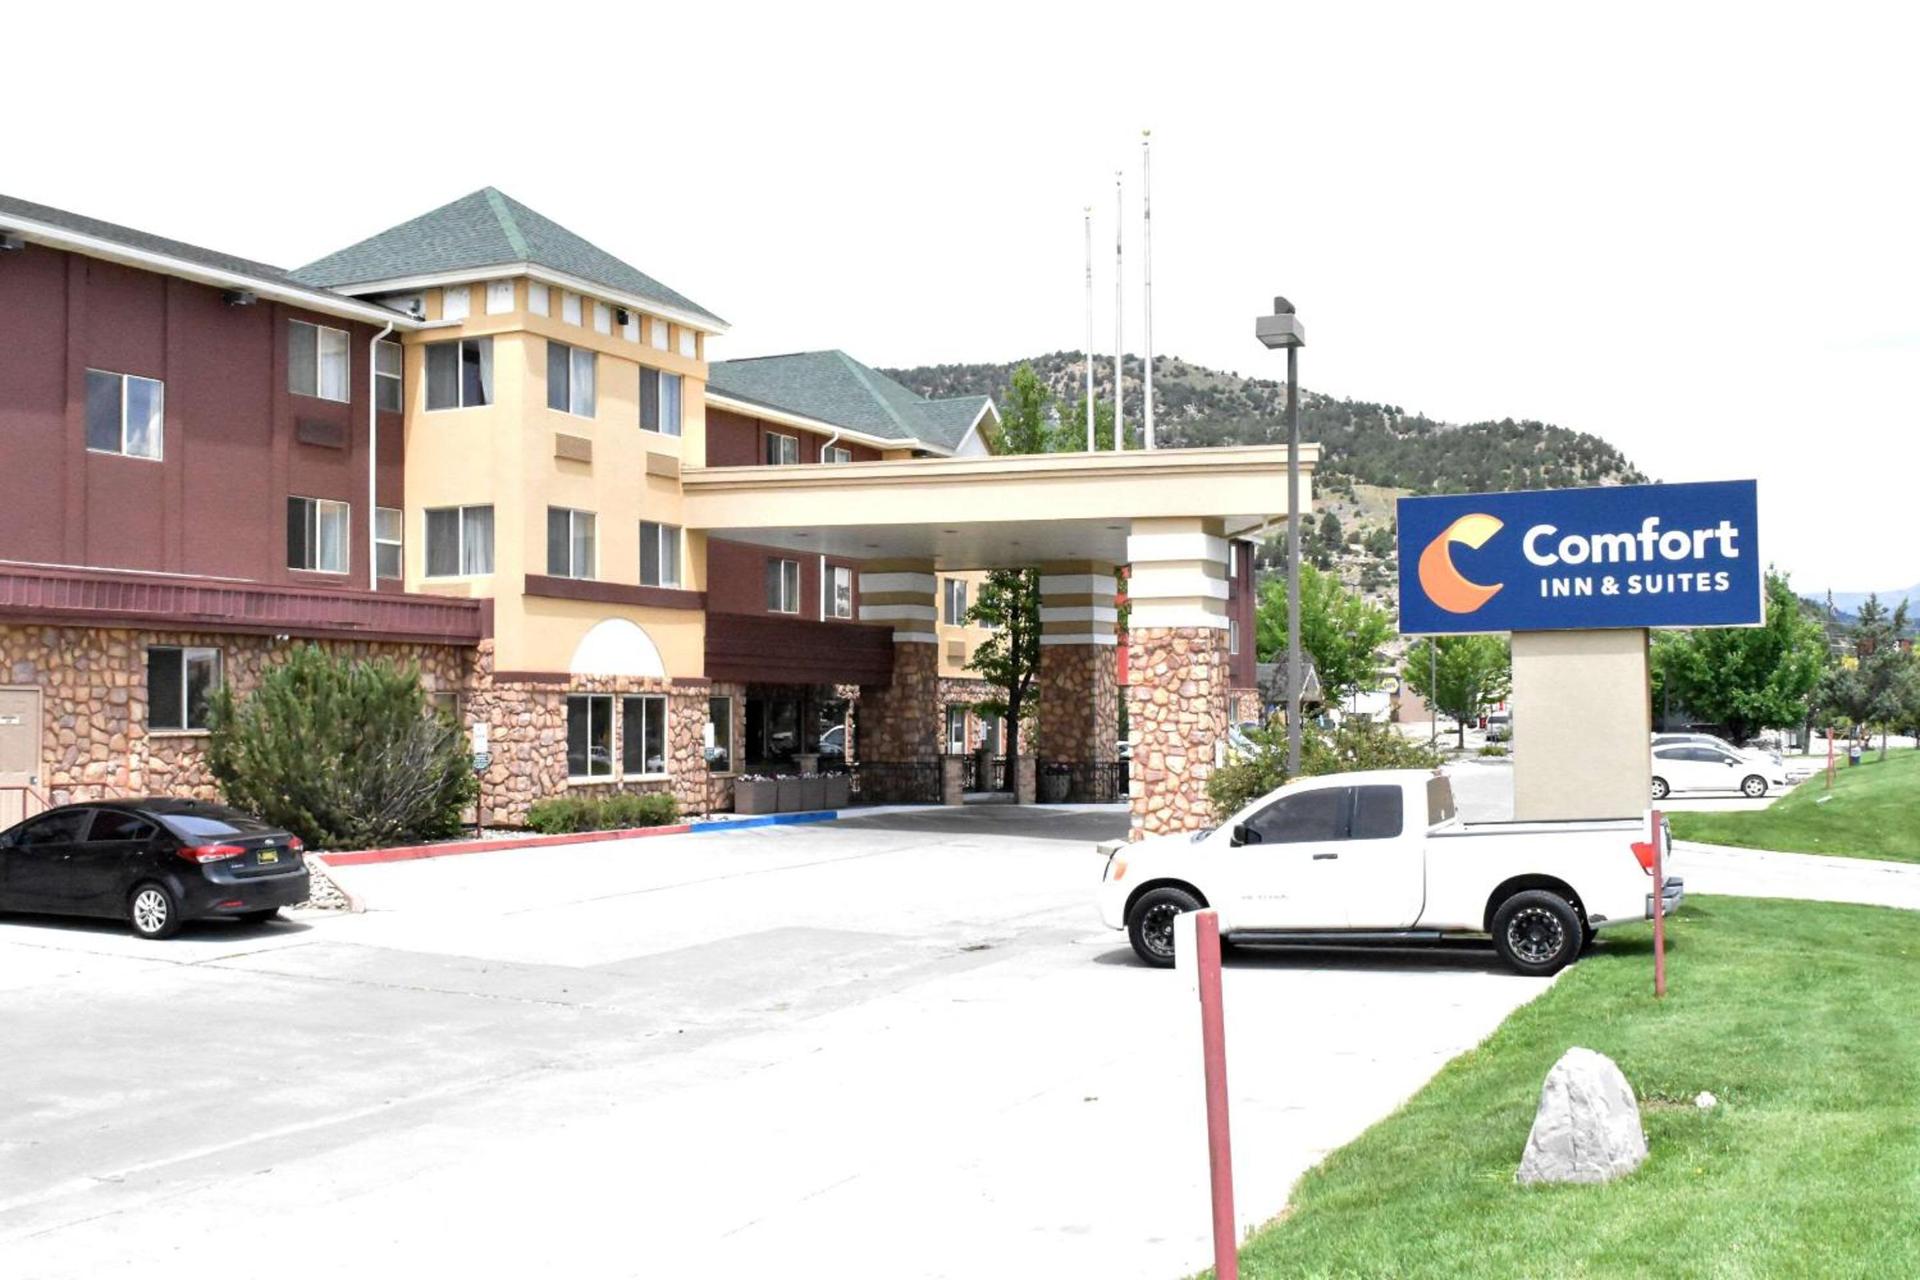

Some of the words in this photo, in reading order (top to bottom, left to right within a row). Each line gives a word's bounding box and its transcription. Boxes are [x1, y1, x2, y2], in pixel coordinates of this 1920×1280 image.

[1522, 516, 1739, 567] Comfort
[1541, 577, 1594, 597] INN
[1600, 575, 1620, 596] &
[1627, 571, 1730, 595] SUITES
